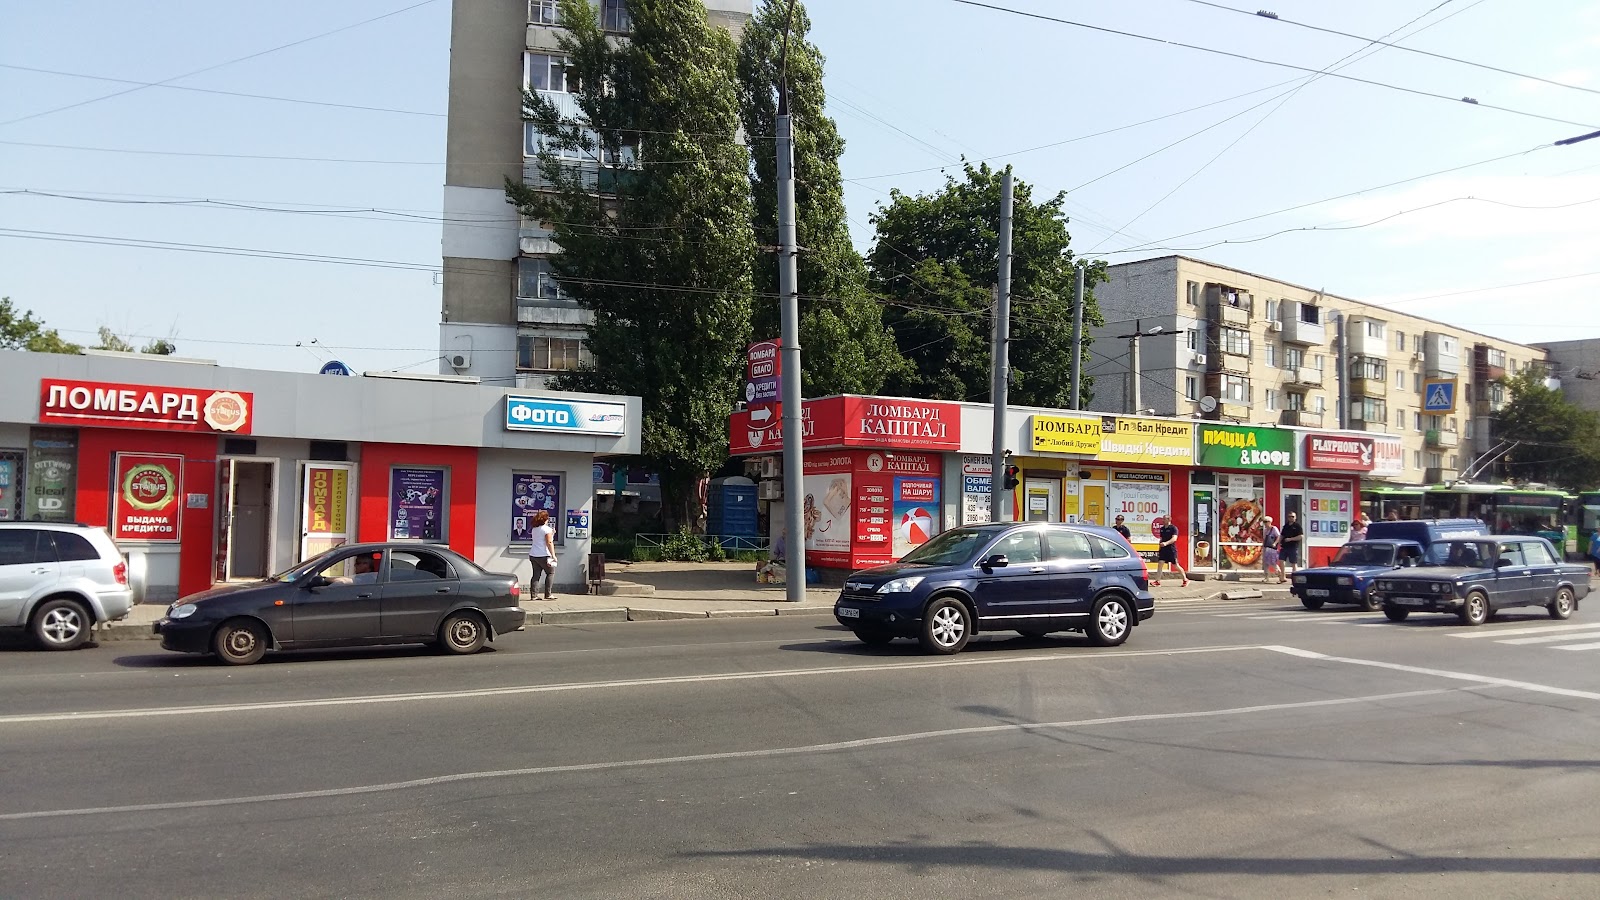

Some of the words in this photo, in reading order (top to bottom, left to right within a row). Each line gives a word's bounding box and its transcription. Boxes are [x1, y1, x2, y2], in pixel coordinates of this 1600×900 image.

[750, 348, 775, 360] ЛОМБАРД
[754, 364, 771, 374] БЛАГО
[756, 381, 776, 391] КРЕДИТИ
[46, 385, 198, 420] ЛОМБАРД
[211, 407, 240, 415] STATUS
[867, 404, 940, 421] ЛОМБАРД
[860, 418, 947, 438] КАПІТАЛ
[1035, 420, 1100, 437] ЛОМБАРД
[1155, 423, 1188, 435] Кредит
[1203, 429, 1257, 448] ПИЦЦА
[1101, 440, 1143, 455] Швидкі
[1145, 443, 1191, 458] Кредити
[1313, 439, 1359, 453] PLAYPHONE
[1375, 442, 1401, 460] РОДАМ
[830, 457, 851, 466] ЗОЛОТА
[891, 455, 926, 463] ЛОМБАРД
[964, 456, 980, 464] ОБМЕН
[888, 462, 929, 471] КАПІТАЛ
[34, 486, 67, 495] Eleaf
[132, 482, 166, 490] STATUS
[312, 471, 327, 531] ЛОМБАРД
[1122, 501, 1134, 513] 10
[1137, 501, 1158, 513] 000
[127, 515, 168, 525] ВЫДАЧА
[122, 525, 172, 533] КРЕДИТОВ
